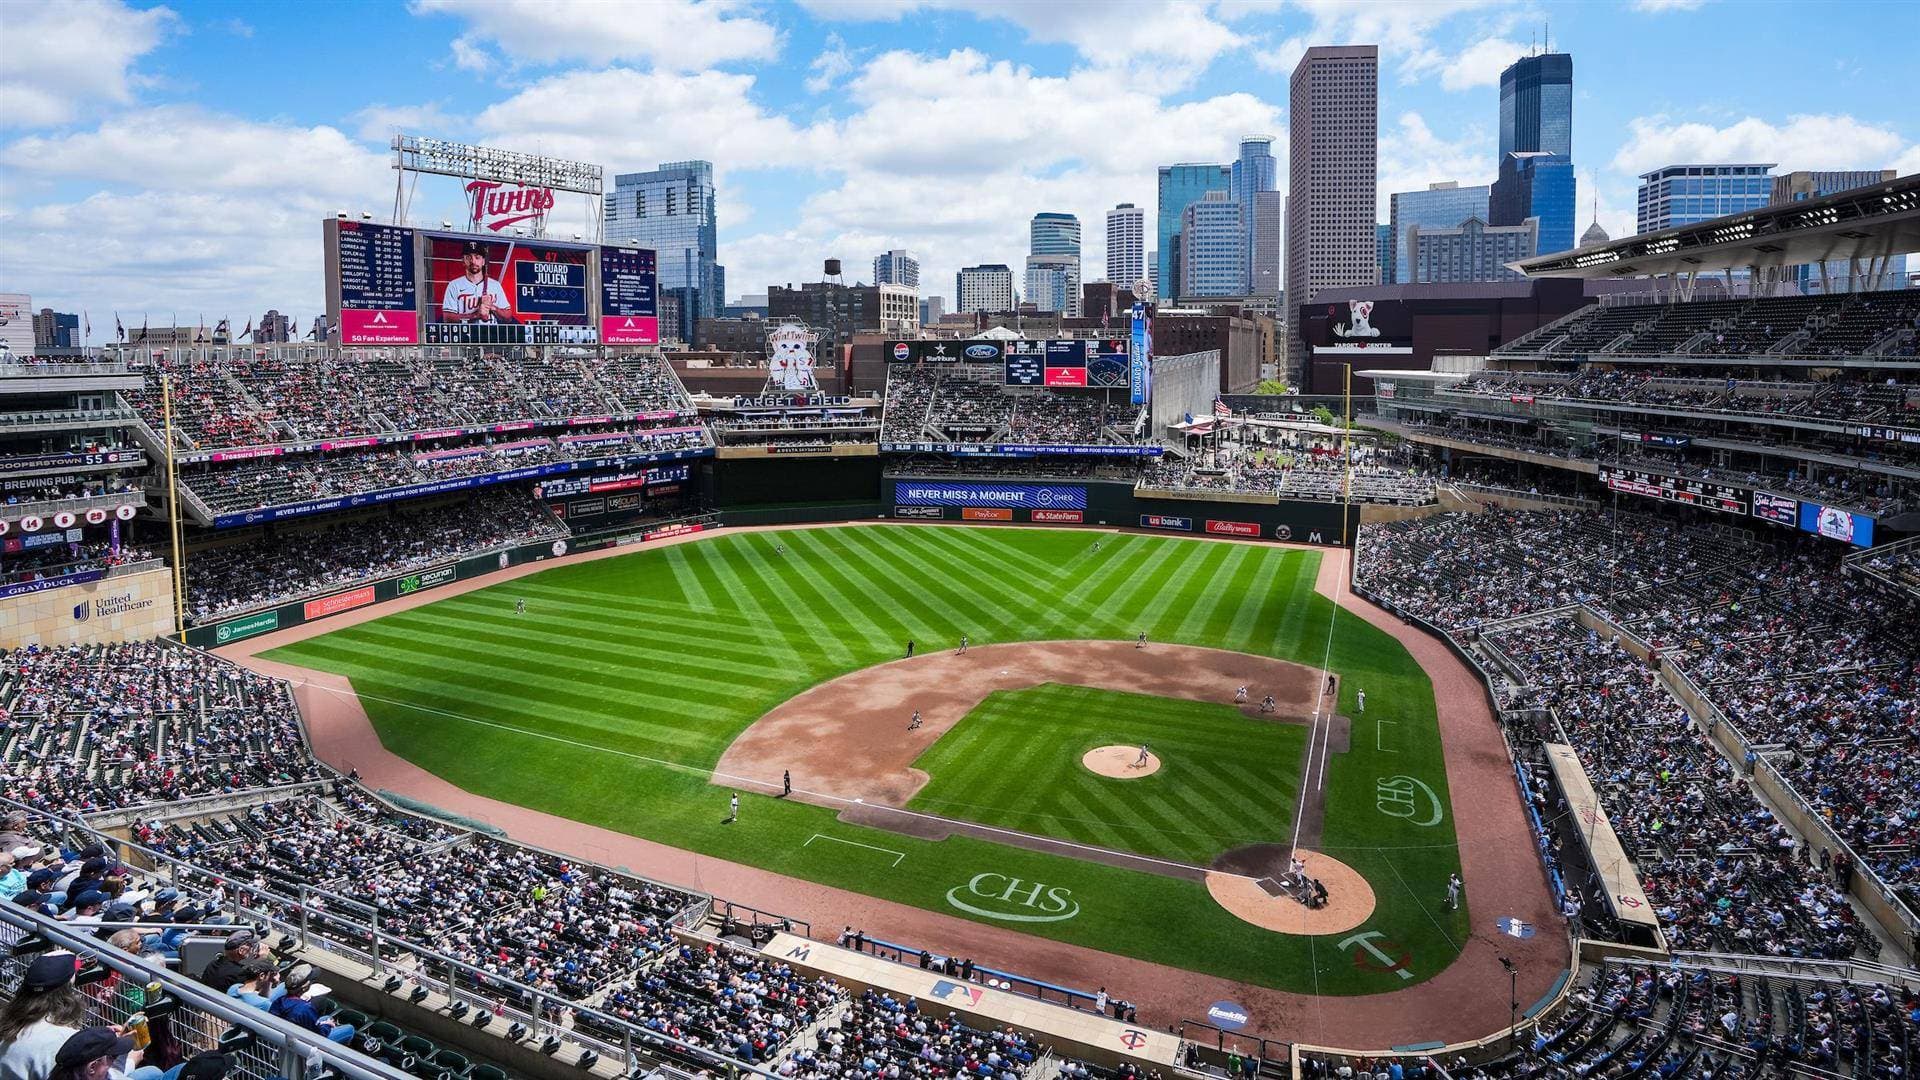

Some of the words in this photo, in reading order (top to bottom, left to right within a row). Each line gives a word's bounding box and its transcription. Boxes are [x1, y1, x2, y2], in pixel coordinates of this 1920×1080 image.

[466, 179, 554, 222] Twins
[534, 264, 568, 274] EDOUARD
[535, 272, 568, 285] JULIEN
[522, 286, 534, 296] 0-1
[1132, 310, 1144, 320] 47
[972, 348, 992, 356] Ford
[736, 398, 794, 408] TARGET
[809, 396, 851, 406] FIELD
[221, 452, 252, 460] Treasure
[4, 477, 54, 490] BREWING
[54, 476, 75, 485] PUB
[420, 486, 439, 494] WITHOUT
[908, 490, 940, 500] NEVER
[943, 490, 968, 500] MISS
[970, 492, 977, 500] A
[980, 492, 1025, 501] MOMENT
[317, 501, 340, 510] MOMENT
[974, 510, 1000, 518] Paycor
[26, 520, 38, 528] 14
[62, 516, 68, 524] 6
[1150, 518, 1160, 526] us
[1161, 516, 1182, 526] bank
[1214, 522, 1235, 533] Bally
[1308, 532, 1322, 544] M
[8, 583, 40, 594] GRAY
[44, 578, 74, 588] DUCK
[96, 594, 130, 608] United
[96, 600, 152, 617] Healthcare
[1376, 776, 1416, 818] CHS
[968, 872, 1073, 913] CHS
[786, 946, 810, 962] M
[1208, 1006, 1248, 1022] Franklin
